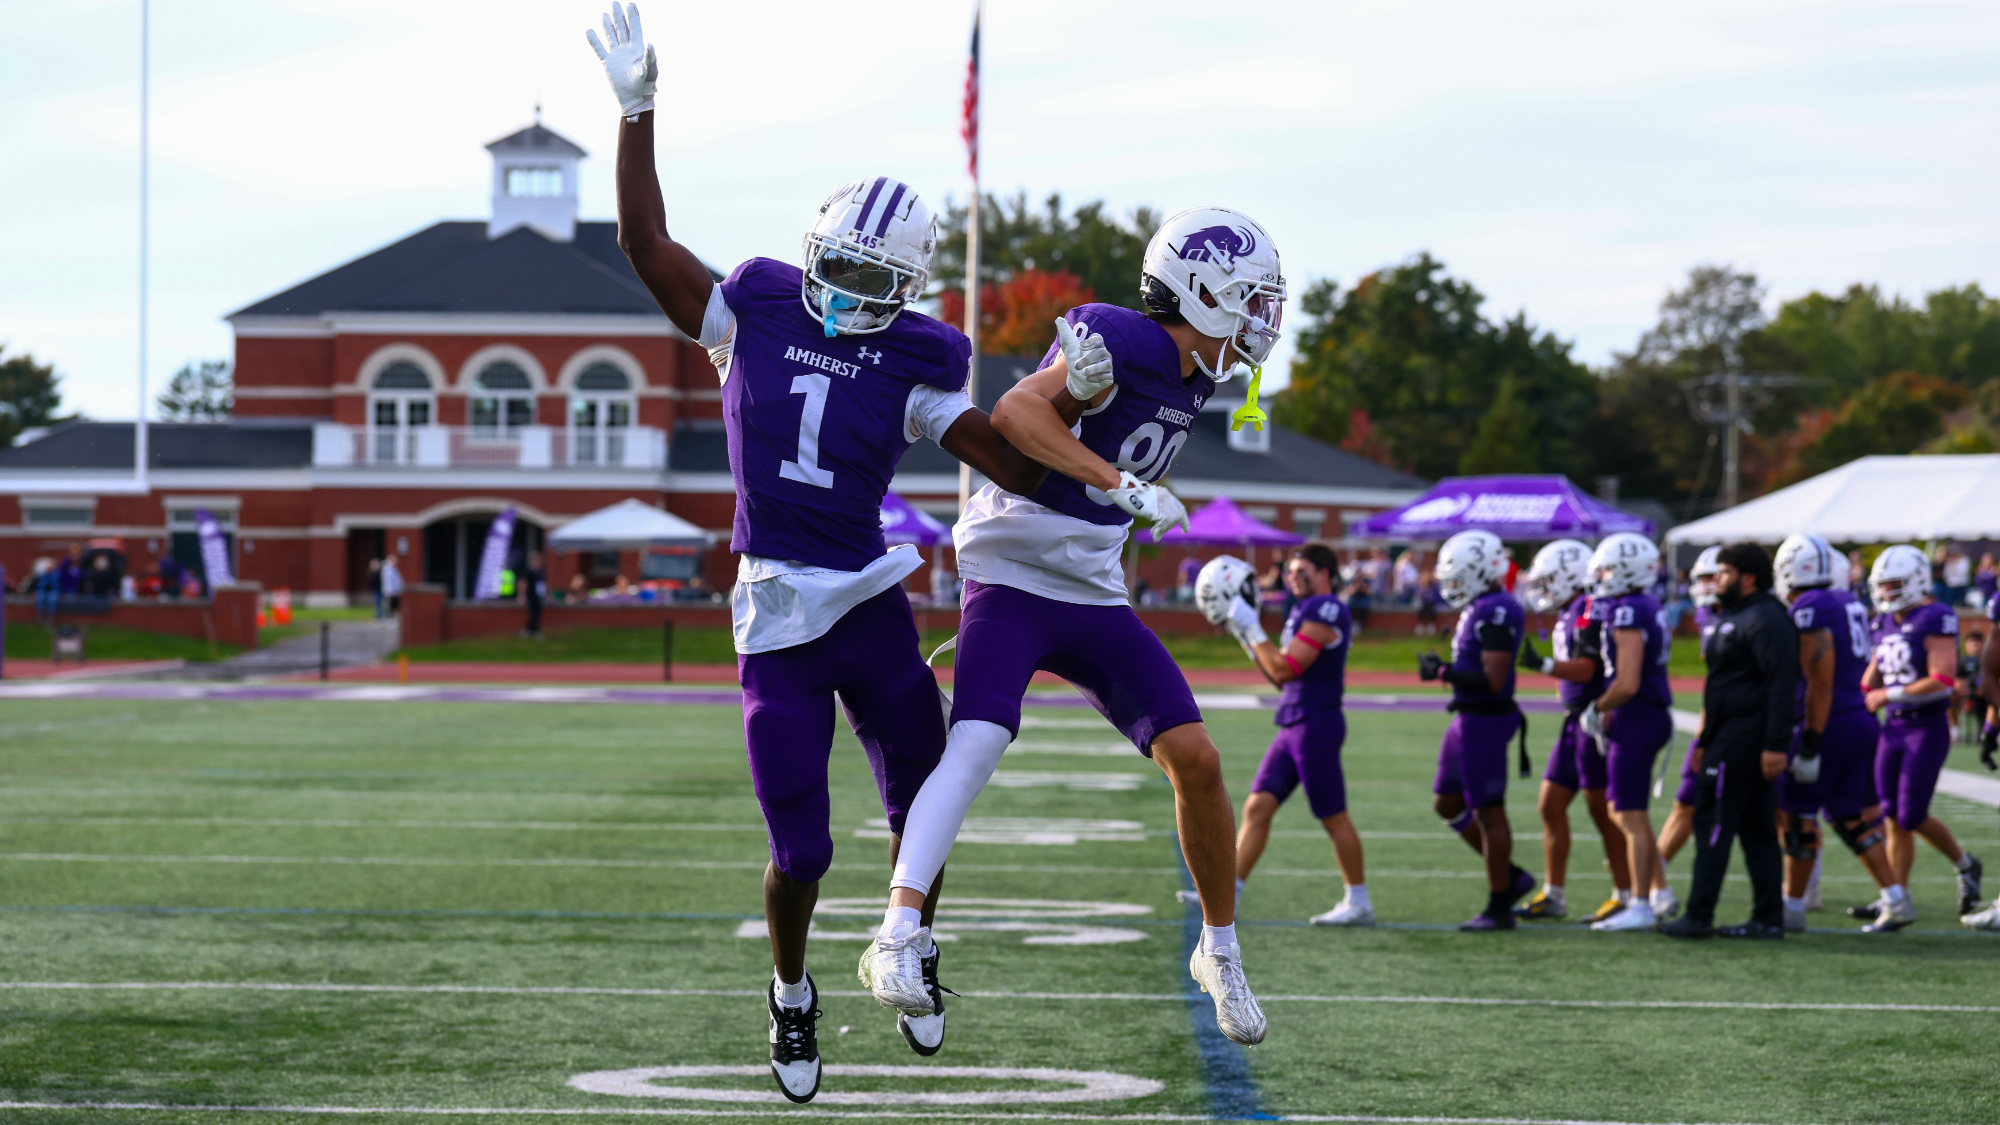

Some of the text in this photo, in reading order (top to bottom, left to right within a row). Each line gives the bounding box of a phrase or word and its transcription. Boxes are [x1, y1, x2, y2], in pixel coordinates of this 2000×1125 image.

[853, 232, 878, 249] 145
[783, 345, 861, 379] AMHERST
[1155, 405, 1194, 428] AMHERST
[779, 372, 834, 489] 1
[1619, 543, 1638, 558] 13
[1491, 606, 1507, 625] 3
[1794, 607, 1814, 629] 67
